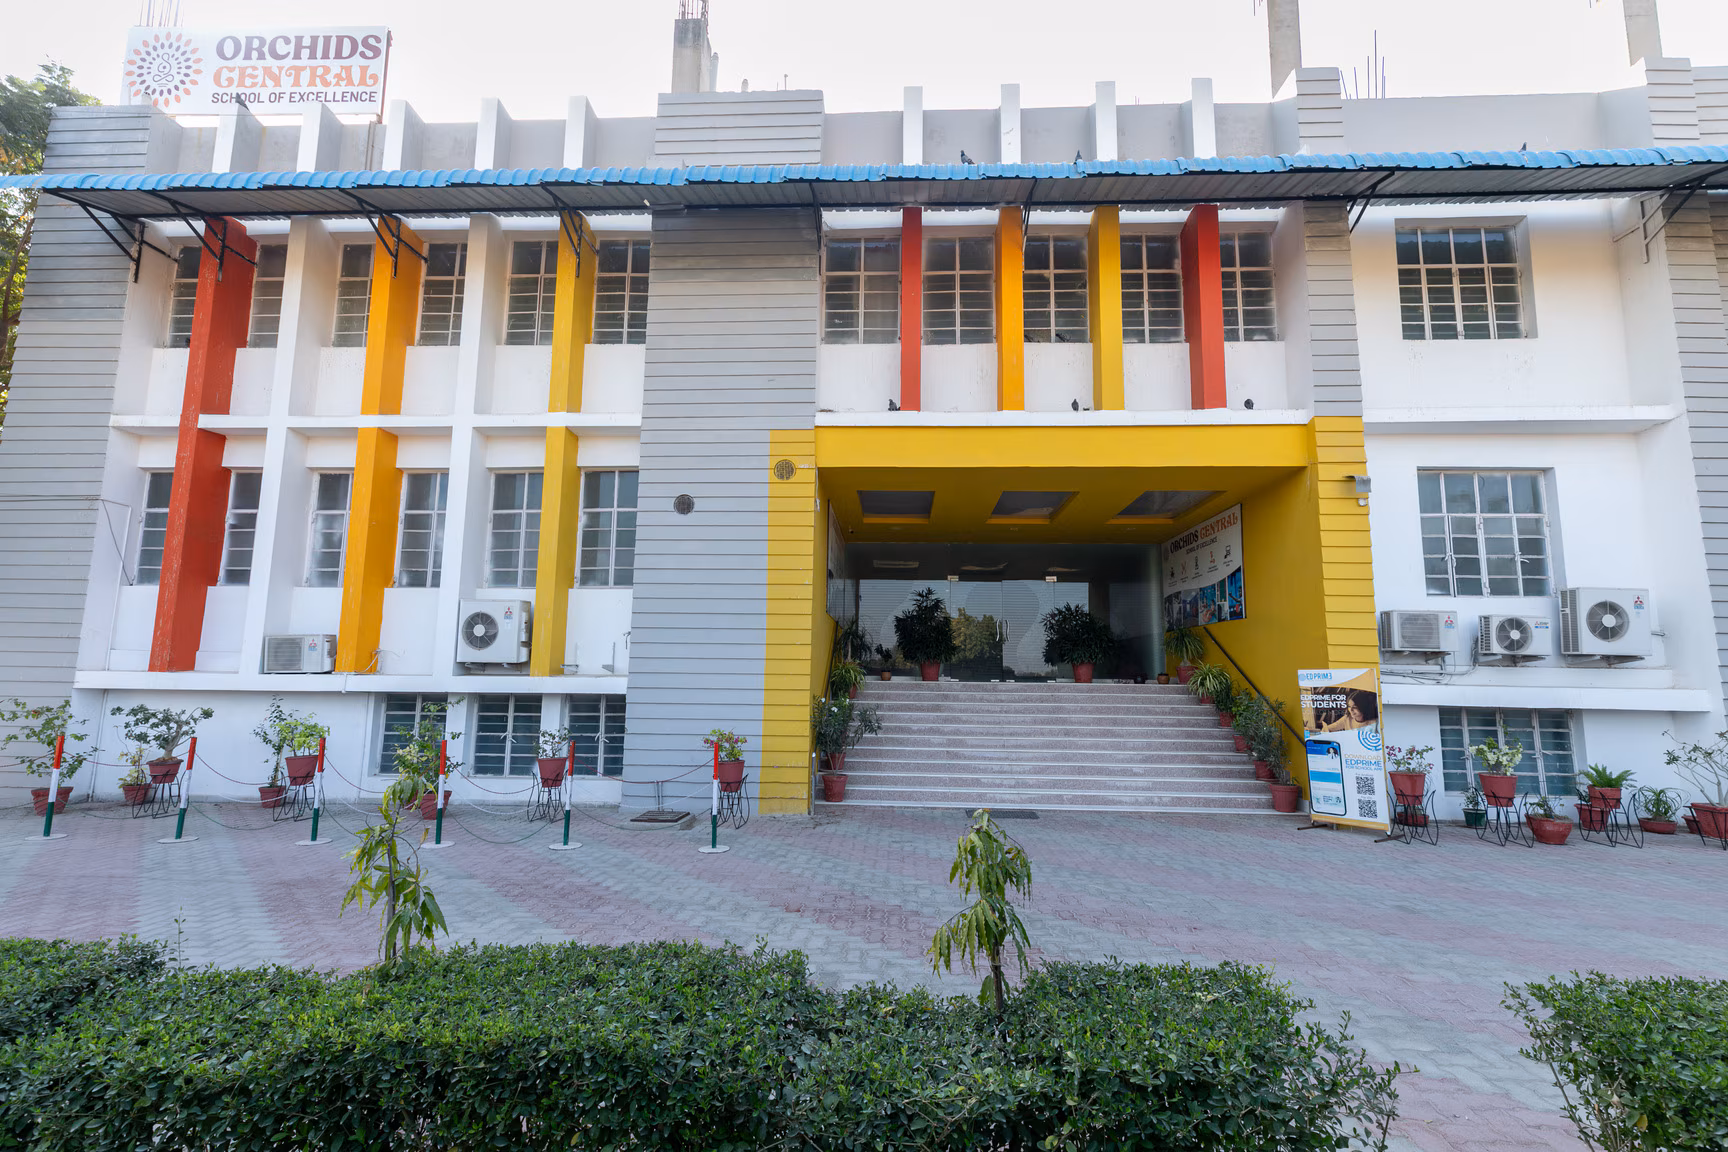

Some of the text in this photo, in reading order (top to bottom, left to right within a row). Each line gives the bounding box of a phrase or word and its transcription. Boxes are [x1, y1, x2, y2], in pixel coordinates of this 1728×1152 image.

[215, 34, 382, 61] ORCHIDS
[213, 64, 379, 88] CENTRAL
[211, 91, 378, 104] SCHOOL OF EXCELLENCE
[1170, 512, 1238, 554] ORCHIDS CENTRAL
[1300, 701, 1347, 709] STUDENTS
[1345, 759, 1382, 767] EDPRIME
